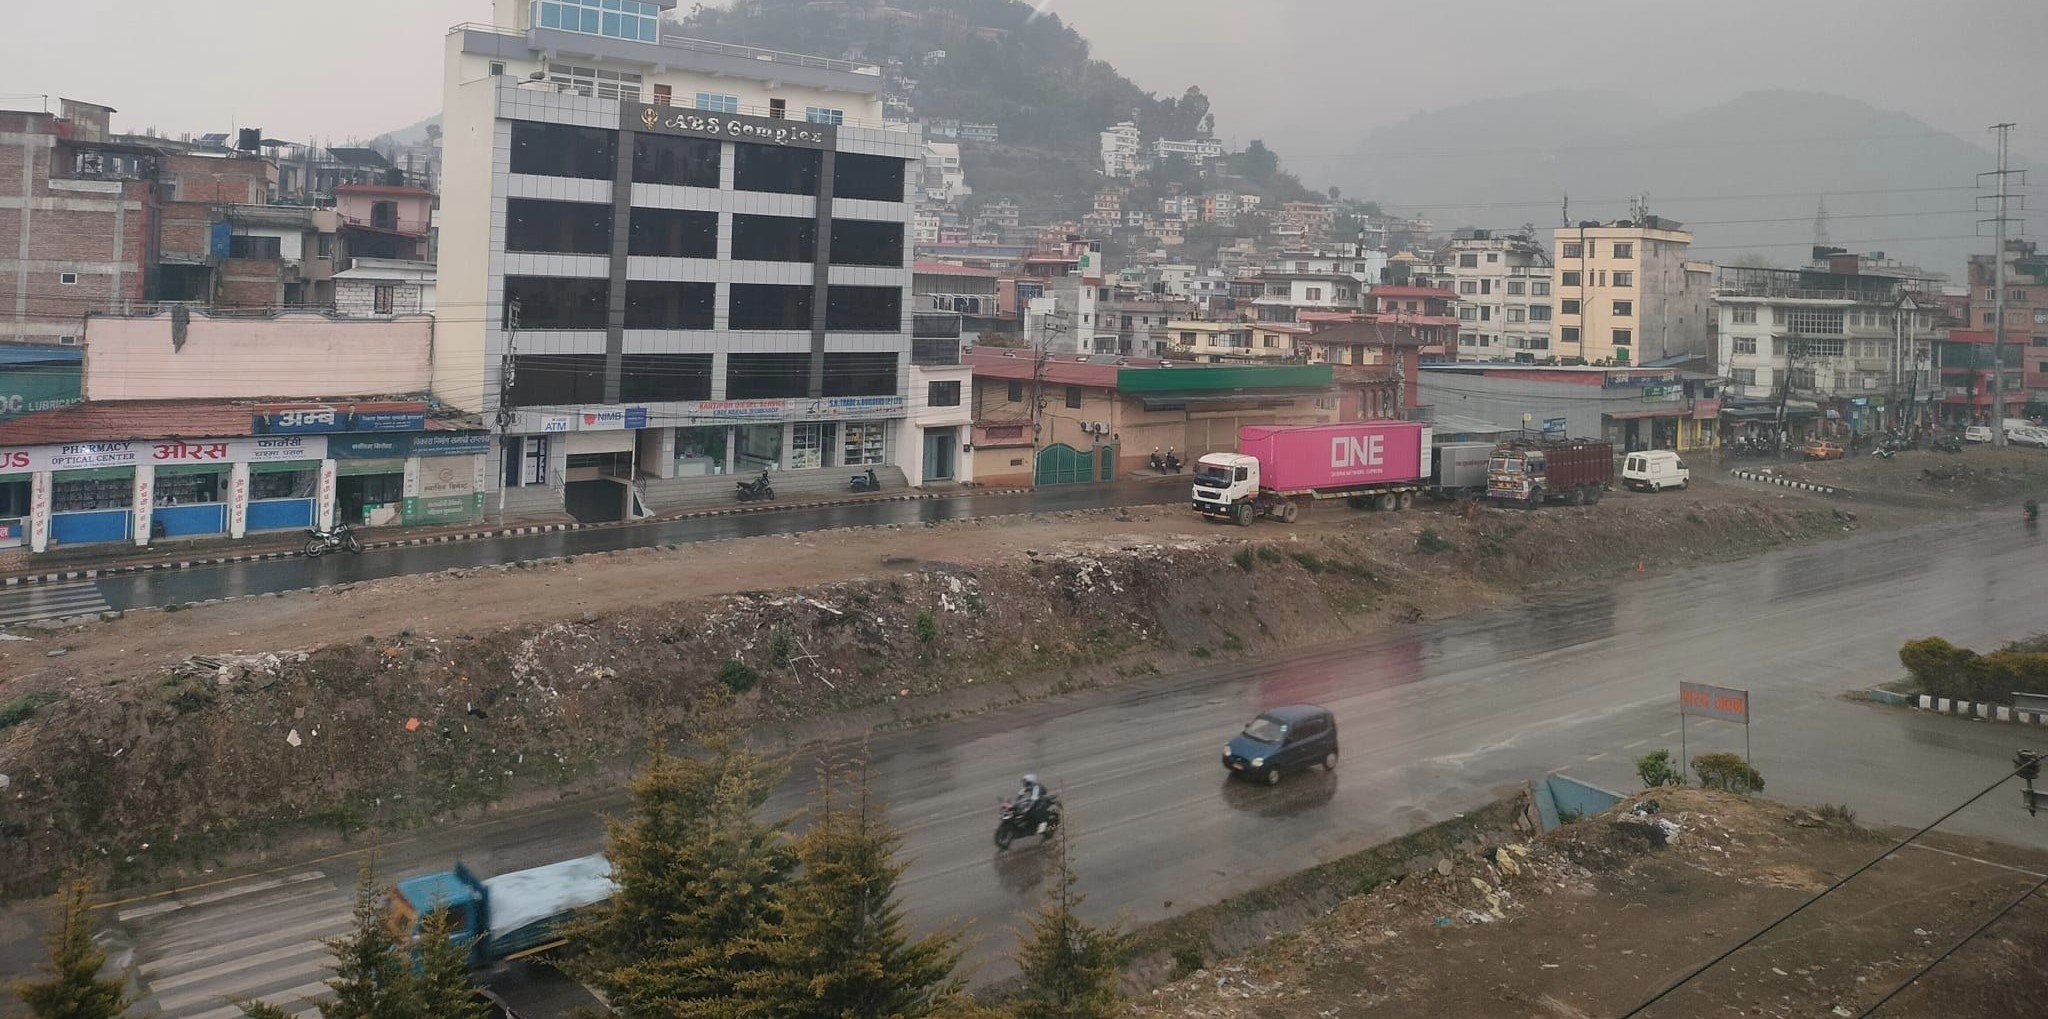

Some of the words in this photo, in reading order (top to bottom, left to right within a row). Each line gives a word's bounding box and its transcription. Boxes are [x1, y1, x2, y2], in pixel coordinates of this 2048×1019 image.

[665, 114, 720, 134] ABS
[727, 120, 823, 145] Complex
[597, 412, 622, 422] NIMB
[544, 422, 566, 431] ATM
[62, 442, 131, 455] PHARMACY
[152, 440, 229, 460] ओरस
[1331, 434, 1384, 468] ONE
[51, 455, 95, 466] OPTICAL
[96, 453, 136, 463] CENTER
